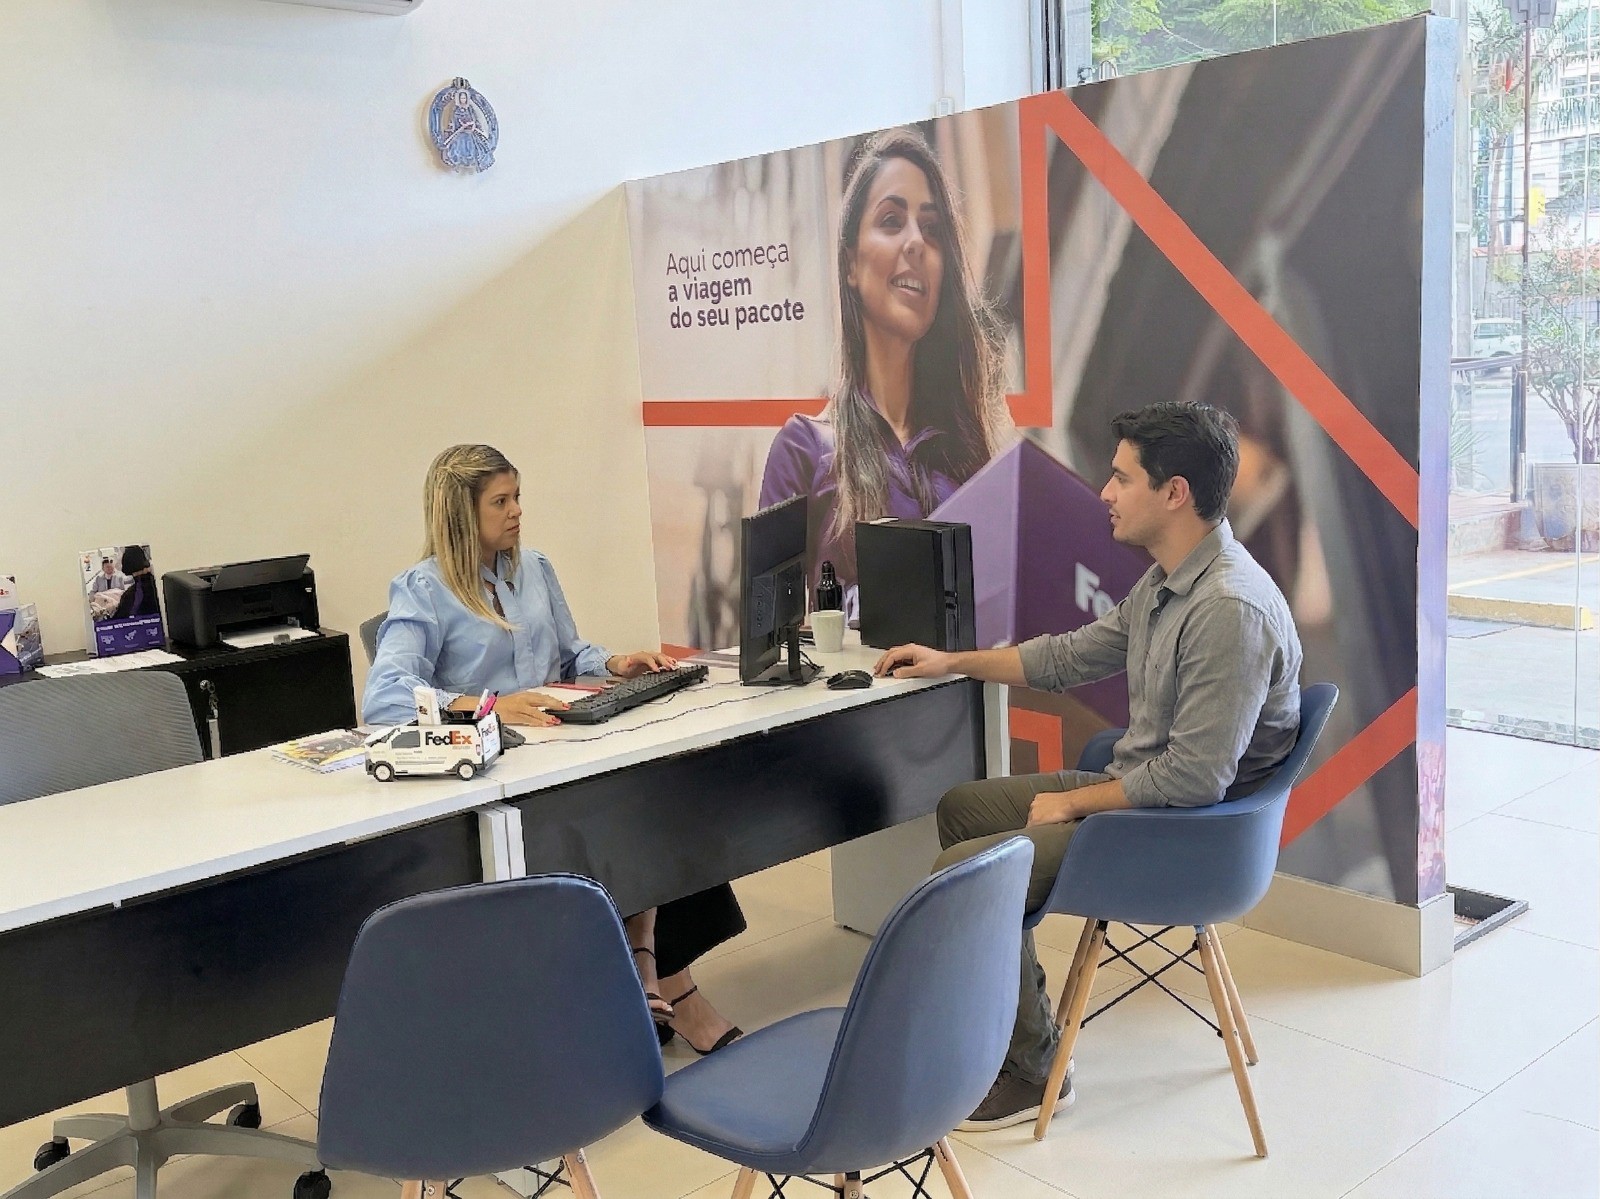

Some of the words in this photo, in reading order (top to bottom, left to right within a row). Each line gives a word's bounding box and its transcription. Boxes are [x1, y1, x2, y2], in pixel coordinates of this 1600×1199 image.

[666, 247, 707, 280] Aqui
[711, 242, 790, 270] começa
[668, 283, 678, 303] a
[683, 276, 752, 305] viagem
[670, 305, 692, 329] do
[697, 307, 729, 327] seu
[735, 298, 805, 331] pacote
[425, 730, 473, 746] FedEx
